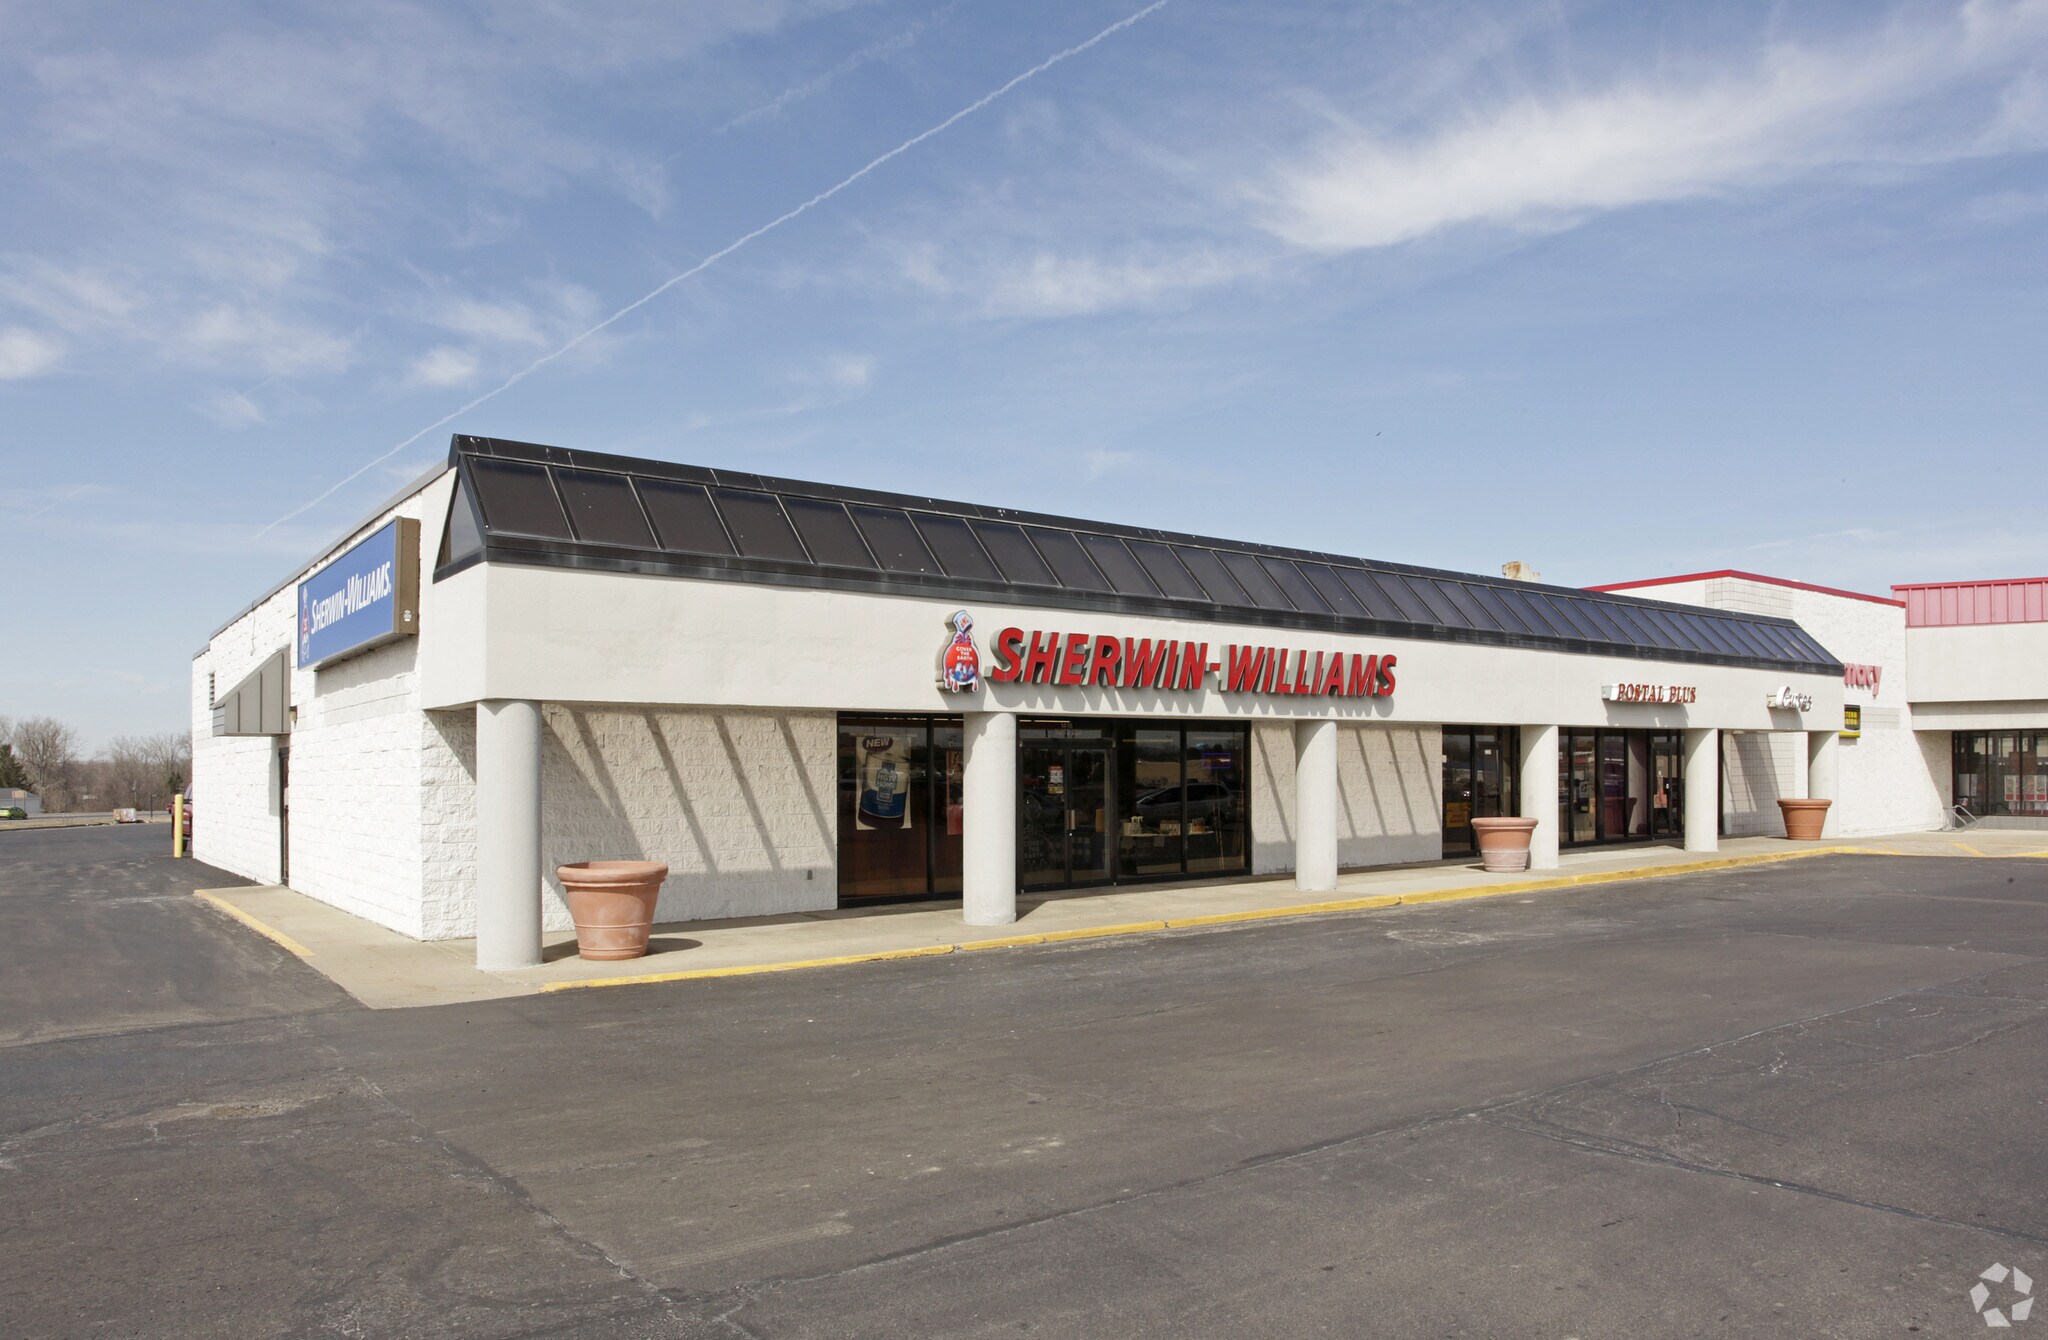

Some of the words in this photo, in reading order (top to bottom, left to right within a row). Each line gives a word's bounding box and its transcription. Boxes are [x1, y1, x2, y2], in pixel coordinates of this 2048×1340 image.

[985, 626, 1398, 698] SHERWIN-WILLIAMS
[1844, 662, 1882, 696] macy
[1616, 683, 1664, 702] POSTAL
[1668, 685, 1696, 703] PLUS
[865, 737, 890, 748] NEW
